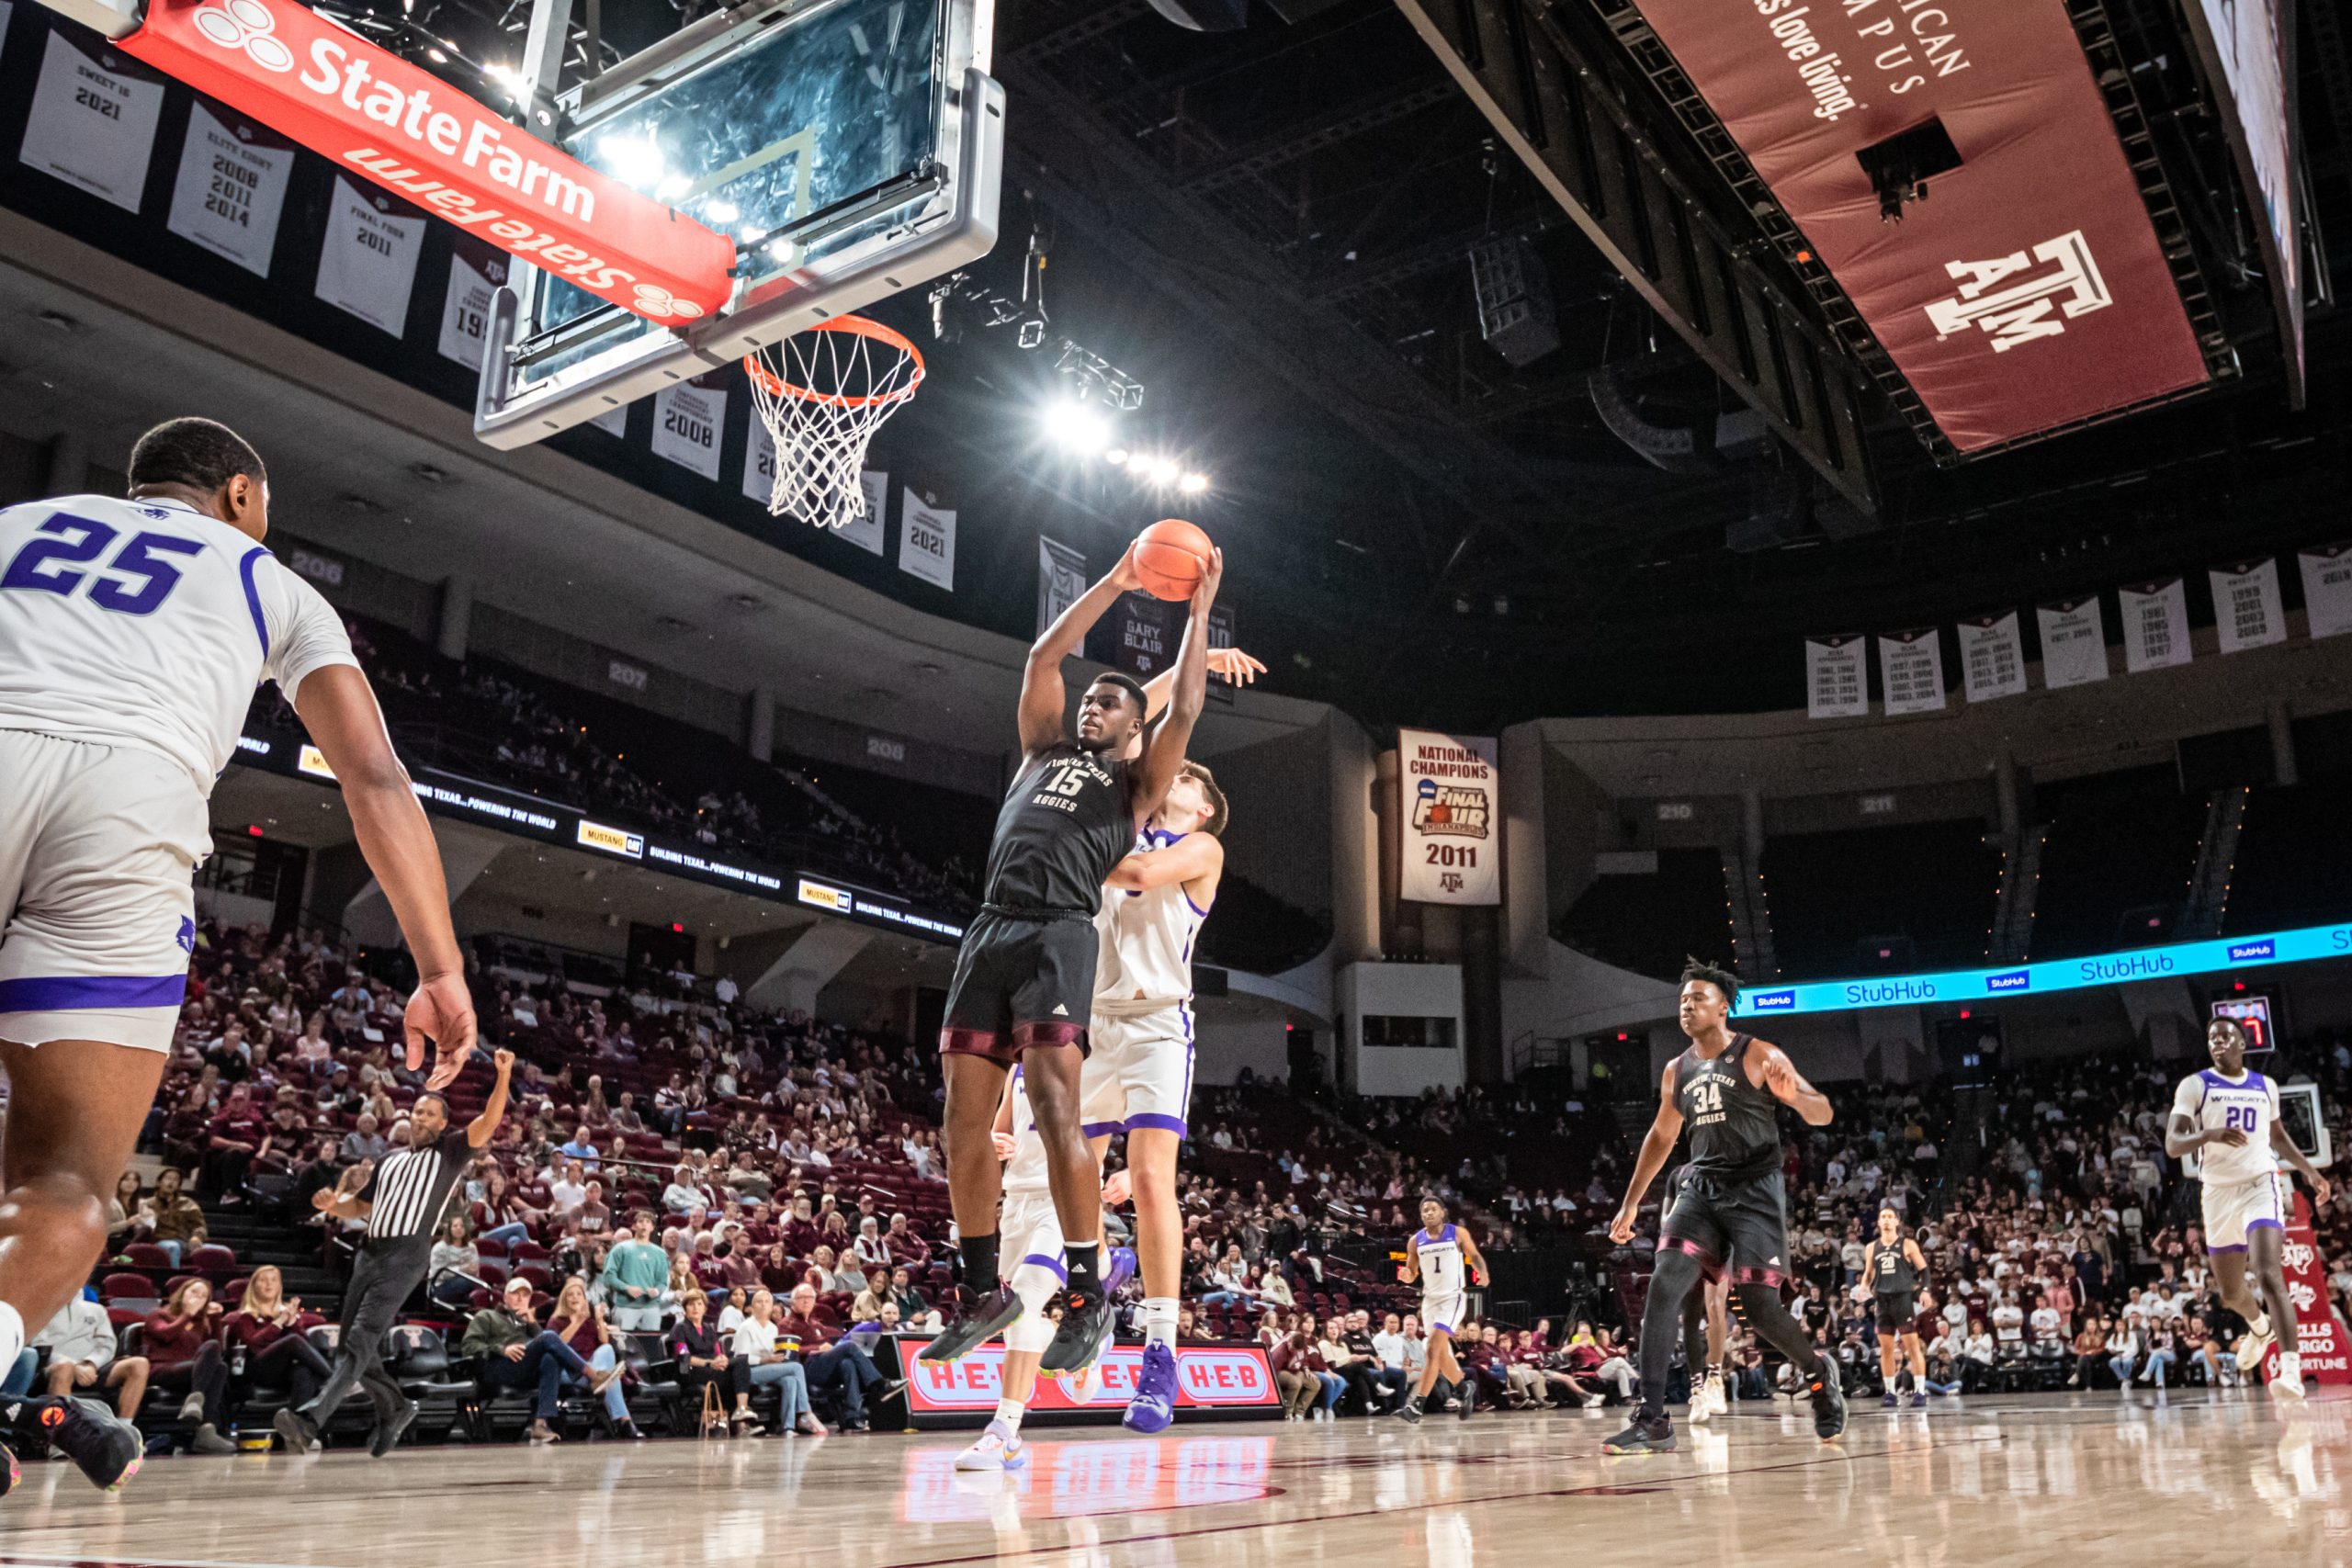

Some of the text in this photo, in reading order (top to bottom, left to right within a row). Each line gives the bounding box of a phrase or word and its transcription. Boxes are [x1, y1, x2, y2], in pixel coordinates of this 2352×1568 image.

[1897, 0, 1972, 77] ICAN
[1769, 6, 1857, 121] love living.
[77, 65, 118, 90] SWEET
[75, 87, 121, 121] 2021
[212, 153, 260, 190] 2008
[210, 175, 253, 207] 2011
[204, 193, 250, 229] 2014
[356, 227, 392, 258] 2011
[457, 308, 488, 339] 19
[664, 408, 713, 449] 2008
[910, 526, 945, 558] 2021
[0, 512, 209, 617] 25
[1126, 620, 1160, 640] GARY
[1124, 633, 1163, 655] BLAIR
[1418, 745, 1480, 763] NATIONAL
[1045, 766, 1091, 796] 15
[1086, 761, 1114, 787] TEXAS
[1409, 761, 1489, 780] CHAMPIONS
[1033, 794, 1078, 813] AGGIES
[1435, 786, 1486, 808] FINAL
[511, 808, 528, 822] THE
[527, 813, 557, 829] WORLD
[587, 829, 624, 847] MUSTANG
[650, 845, 683, 864] BUILDING
[745, 871, 758, 884] THE
[758, 874, 781, 890] WORLD
[1426, 843, 1477, 868] 2011
[806, 888, 835, 903] MUSTANG
[855, 901, 883, 917] BUILDING
[943, 925, 963, 938] WORLD
[1758, 945, 2270, 1007] StubHub StubHub StubHub StubHub StubHub
[1712, 1073, 1736, 1088] TEXAS
[1692, 1083, 1723, 1114] 34
[2211, 1095, 2267, 1103] WILDCATS
[1696, 1111, 1726, 1126] AGGIES
[2226, 1106, 2257, 1133] 20
[1434, 1257, 1442, 1273] 1
[2297, 1323, 2333, 1337] ELLS
[2297, 1338, 2335, 1354] RGO
